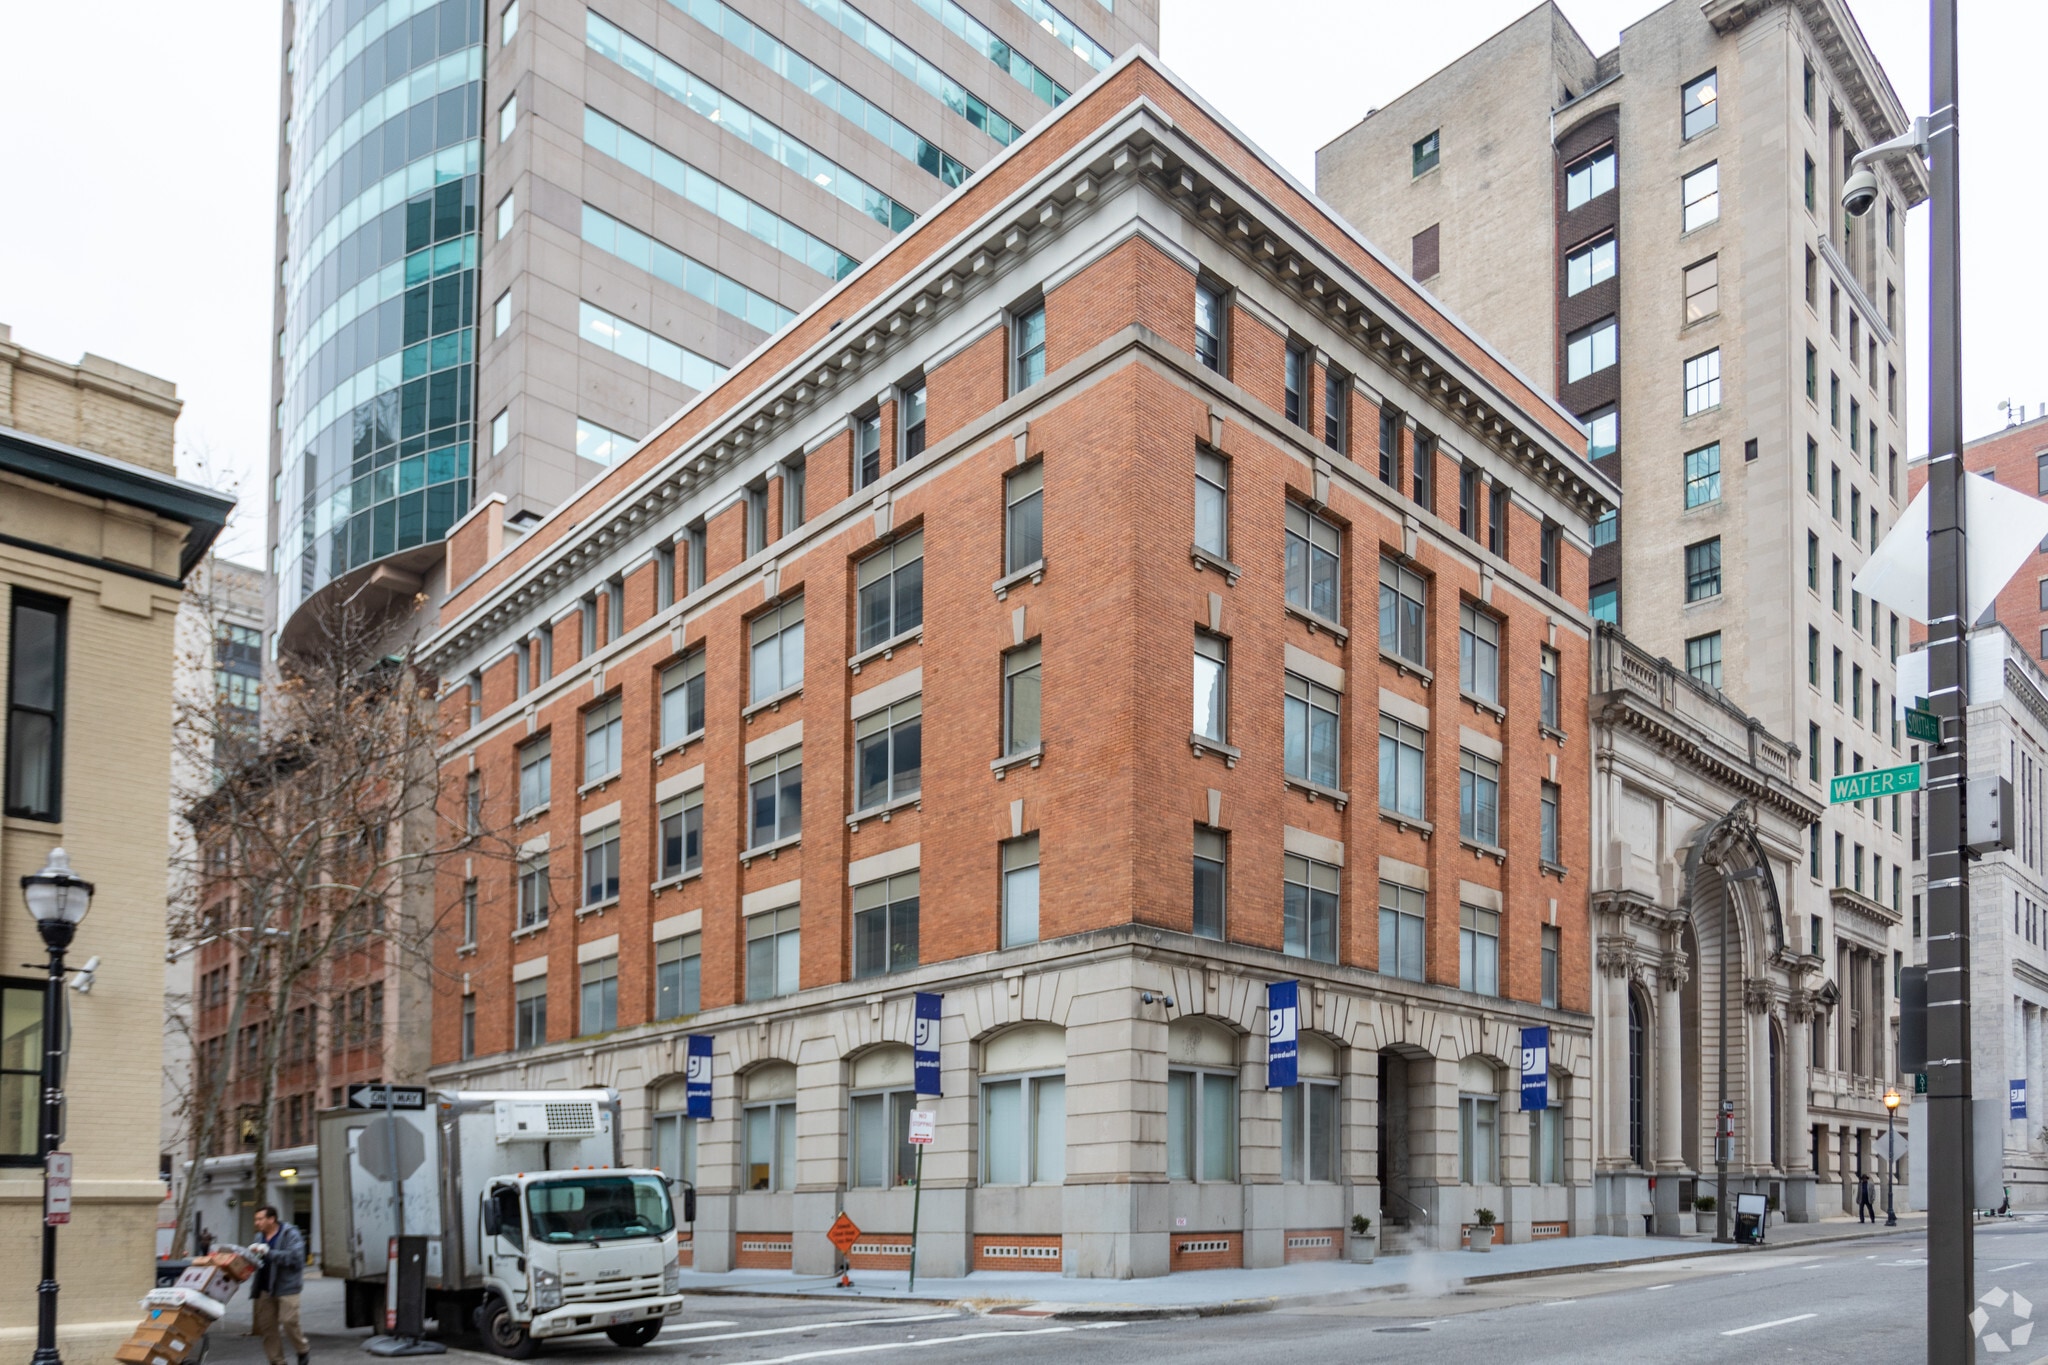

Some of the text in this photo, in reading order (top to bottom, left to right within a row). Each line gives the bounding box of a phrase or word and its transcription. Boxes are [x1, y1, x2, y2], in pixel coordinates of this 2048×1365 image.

[1834, 772, 1895, 799] WATER
[1269, 1049, 1296, 1062] goodwill
[1522, 1080, 1546, 1091] goodwill
